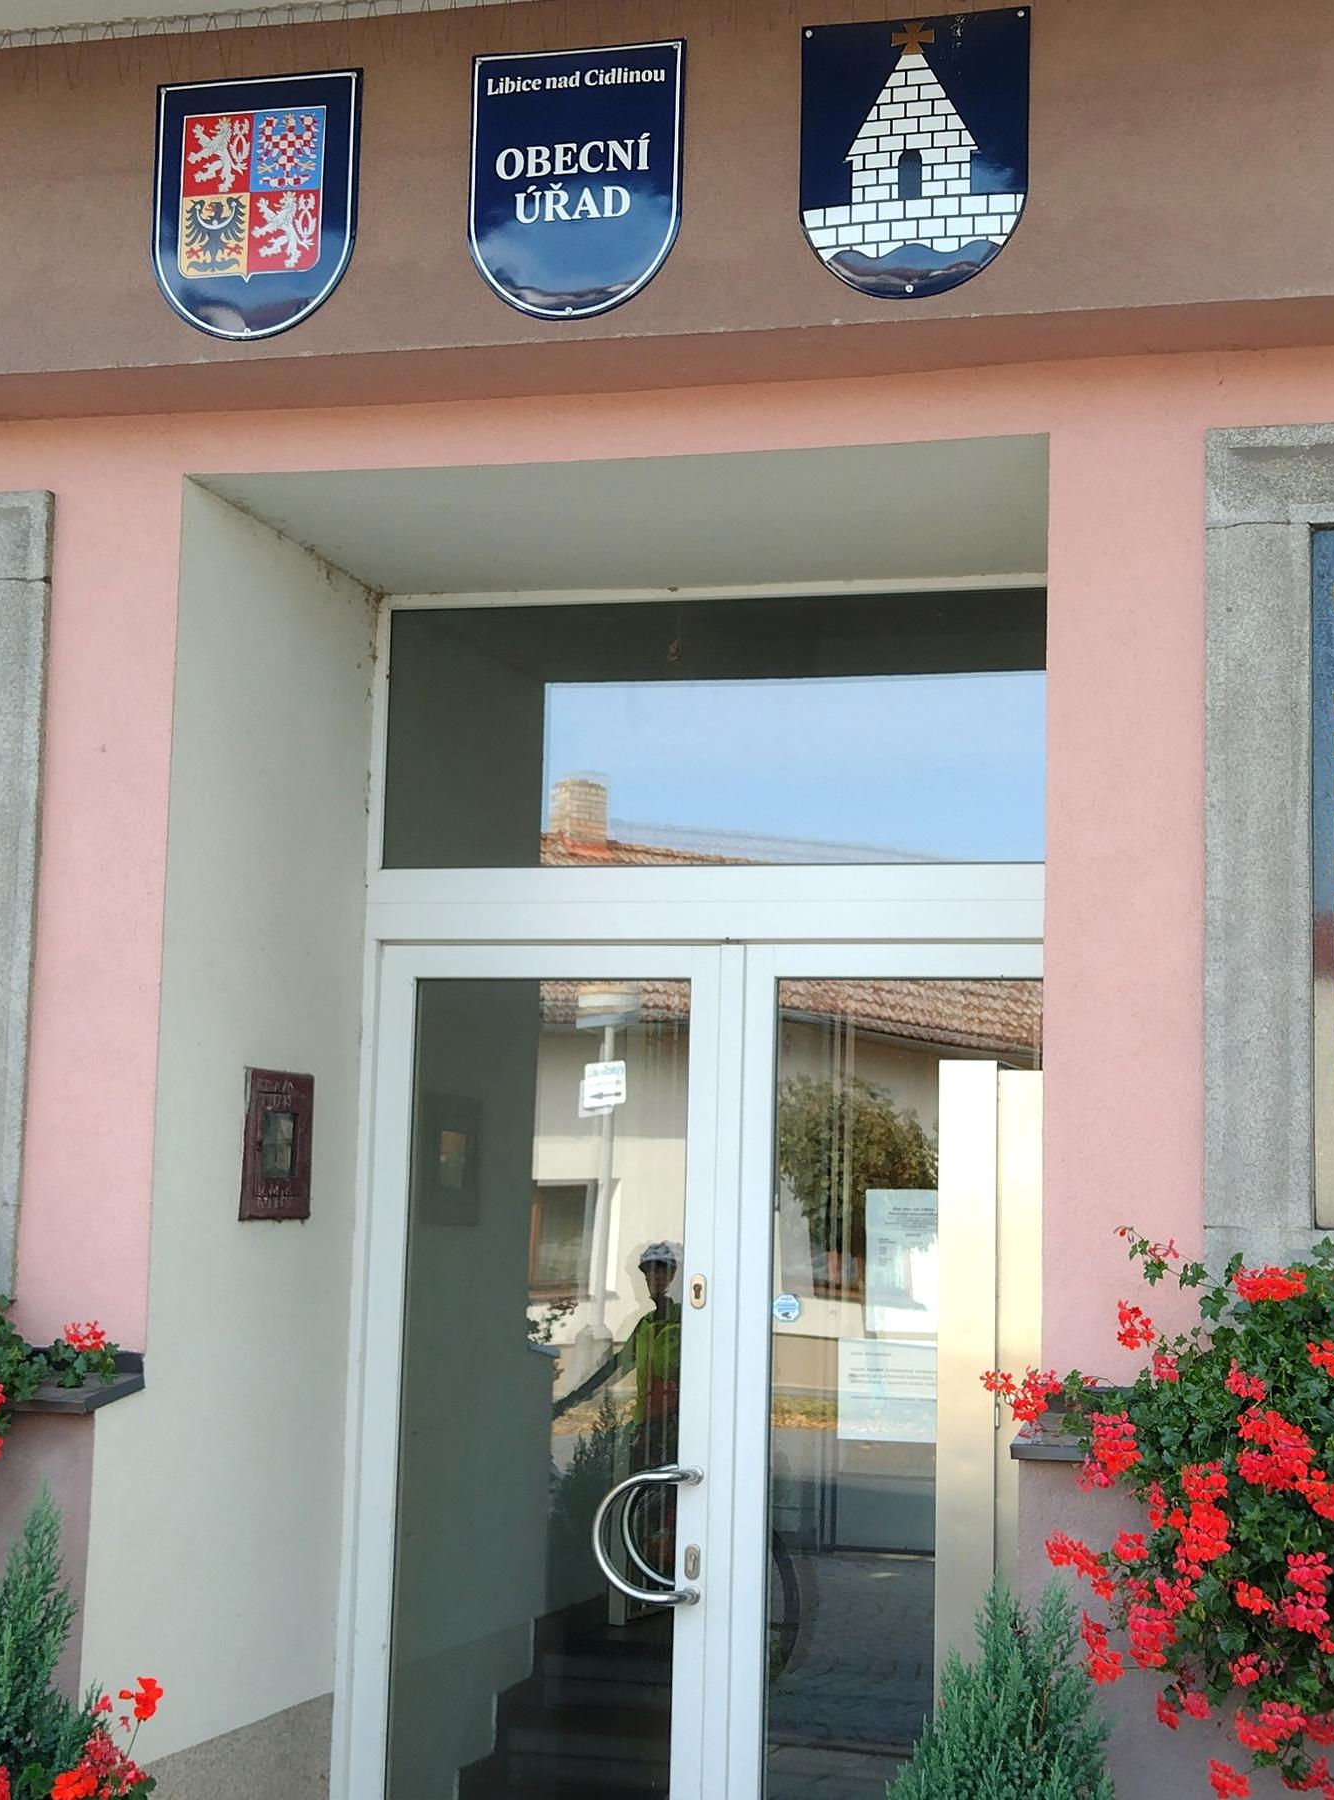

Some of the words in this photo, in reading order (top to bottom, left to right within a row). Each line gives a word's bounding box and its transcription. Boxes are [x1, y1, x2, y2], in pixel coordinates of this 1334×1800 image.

[487, 76, 542, 96] Libice
[545, 71, 580, 89] nad
[584, 68, 665, 86] Cidlinou
[495, 133, 650, 180] OBECNÍ
[515, 182, 631, 224] ÚŘAD
